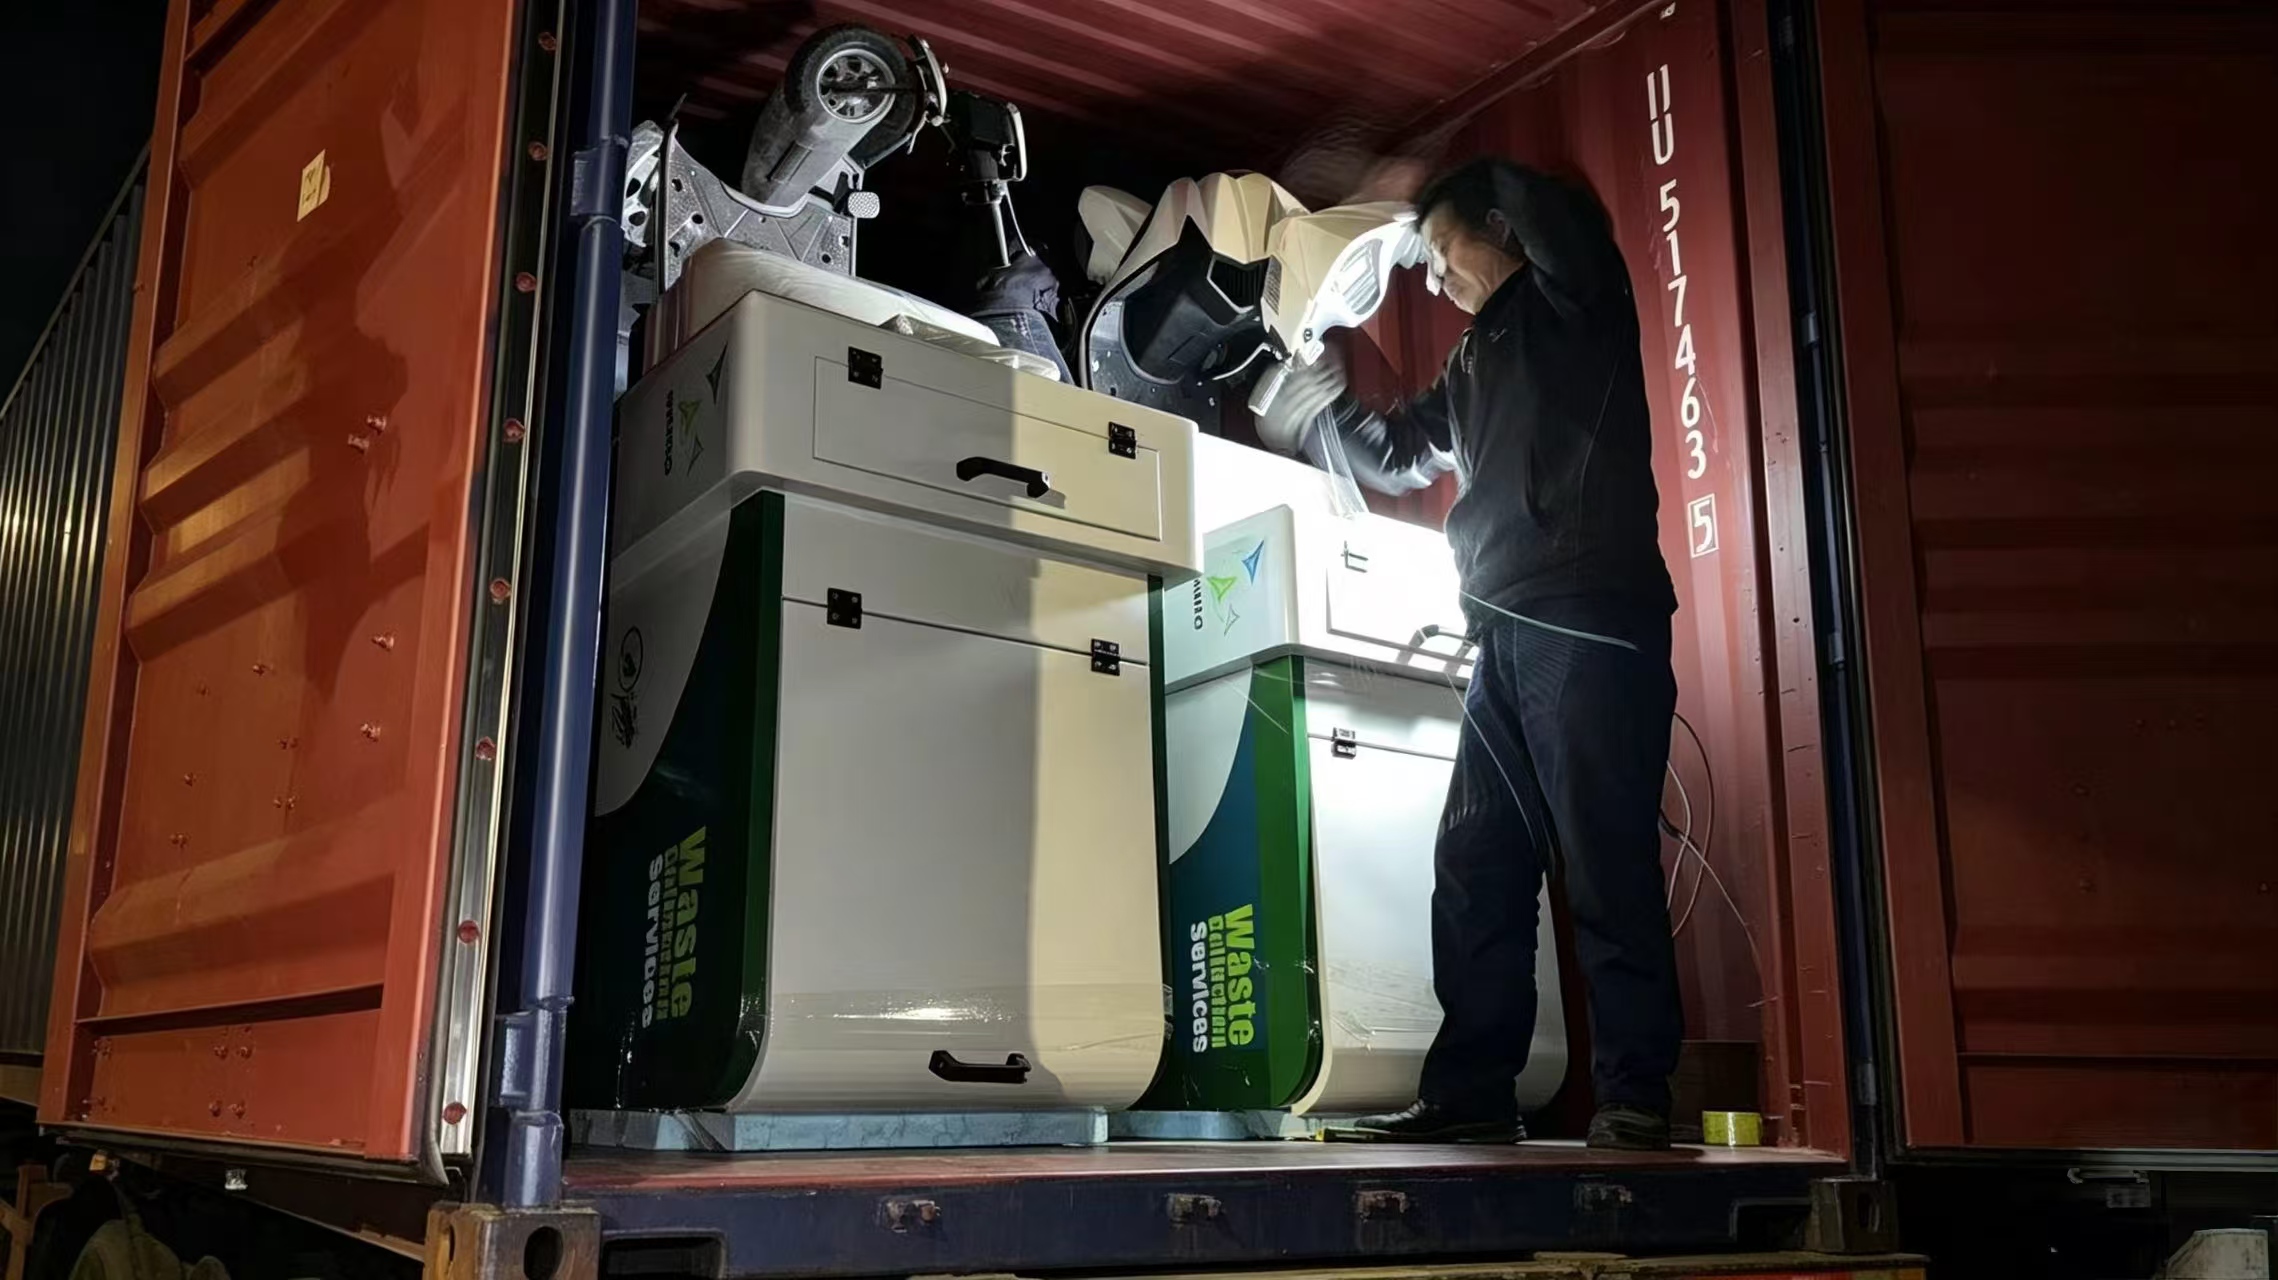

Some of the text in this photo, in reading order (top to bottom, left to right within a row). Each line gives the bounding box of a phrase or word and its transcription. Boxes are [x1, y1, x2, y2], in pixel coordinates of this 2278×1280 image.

[1660, 178, 1706, 480] 517463
[641, 853, 664, 1029] Services
[671, 825, 706, 1019] Waste
[1190, 920, 1210, 1054] Services
[1225, 903, 1256, 1046] Waste
